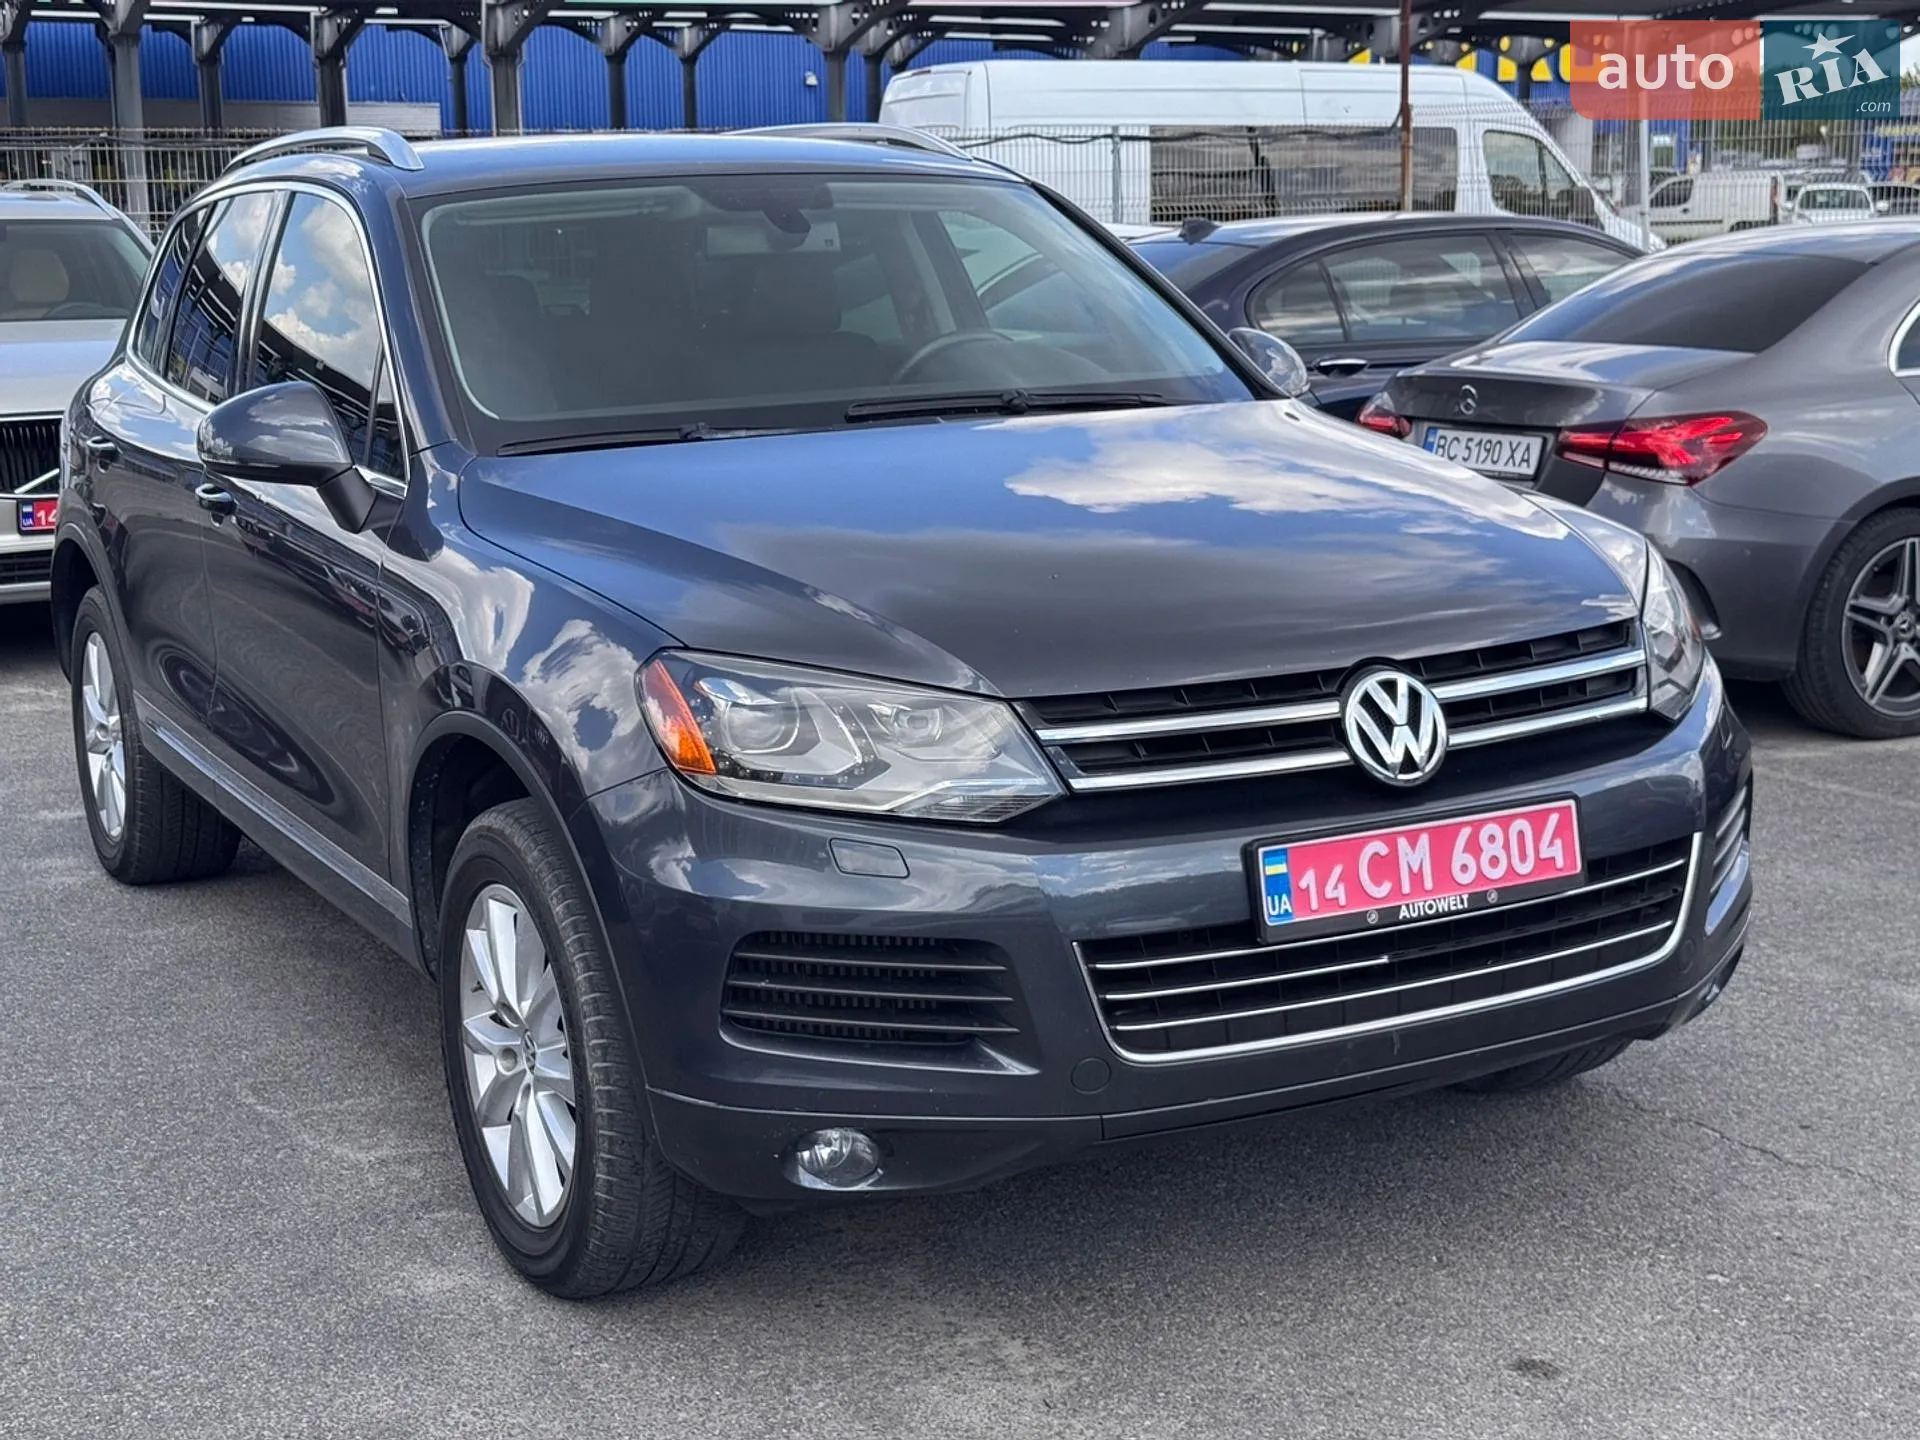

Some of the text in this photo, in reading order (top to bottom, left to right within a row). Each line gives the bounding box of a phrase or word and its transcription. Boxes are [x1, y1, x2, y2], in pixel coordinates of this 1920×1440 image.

[1435, 435, 1531, 469] BC 5190 XA
[1298, 812, 1565, 911] 14 CM 6804
[1267, 894, 1292, 916] UA
[1399, 894, 1469, 920] AUTOWELT
